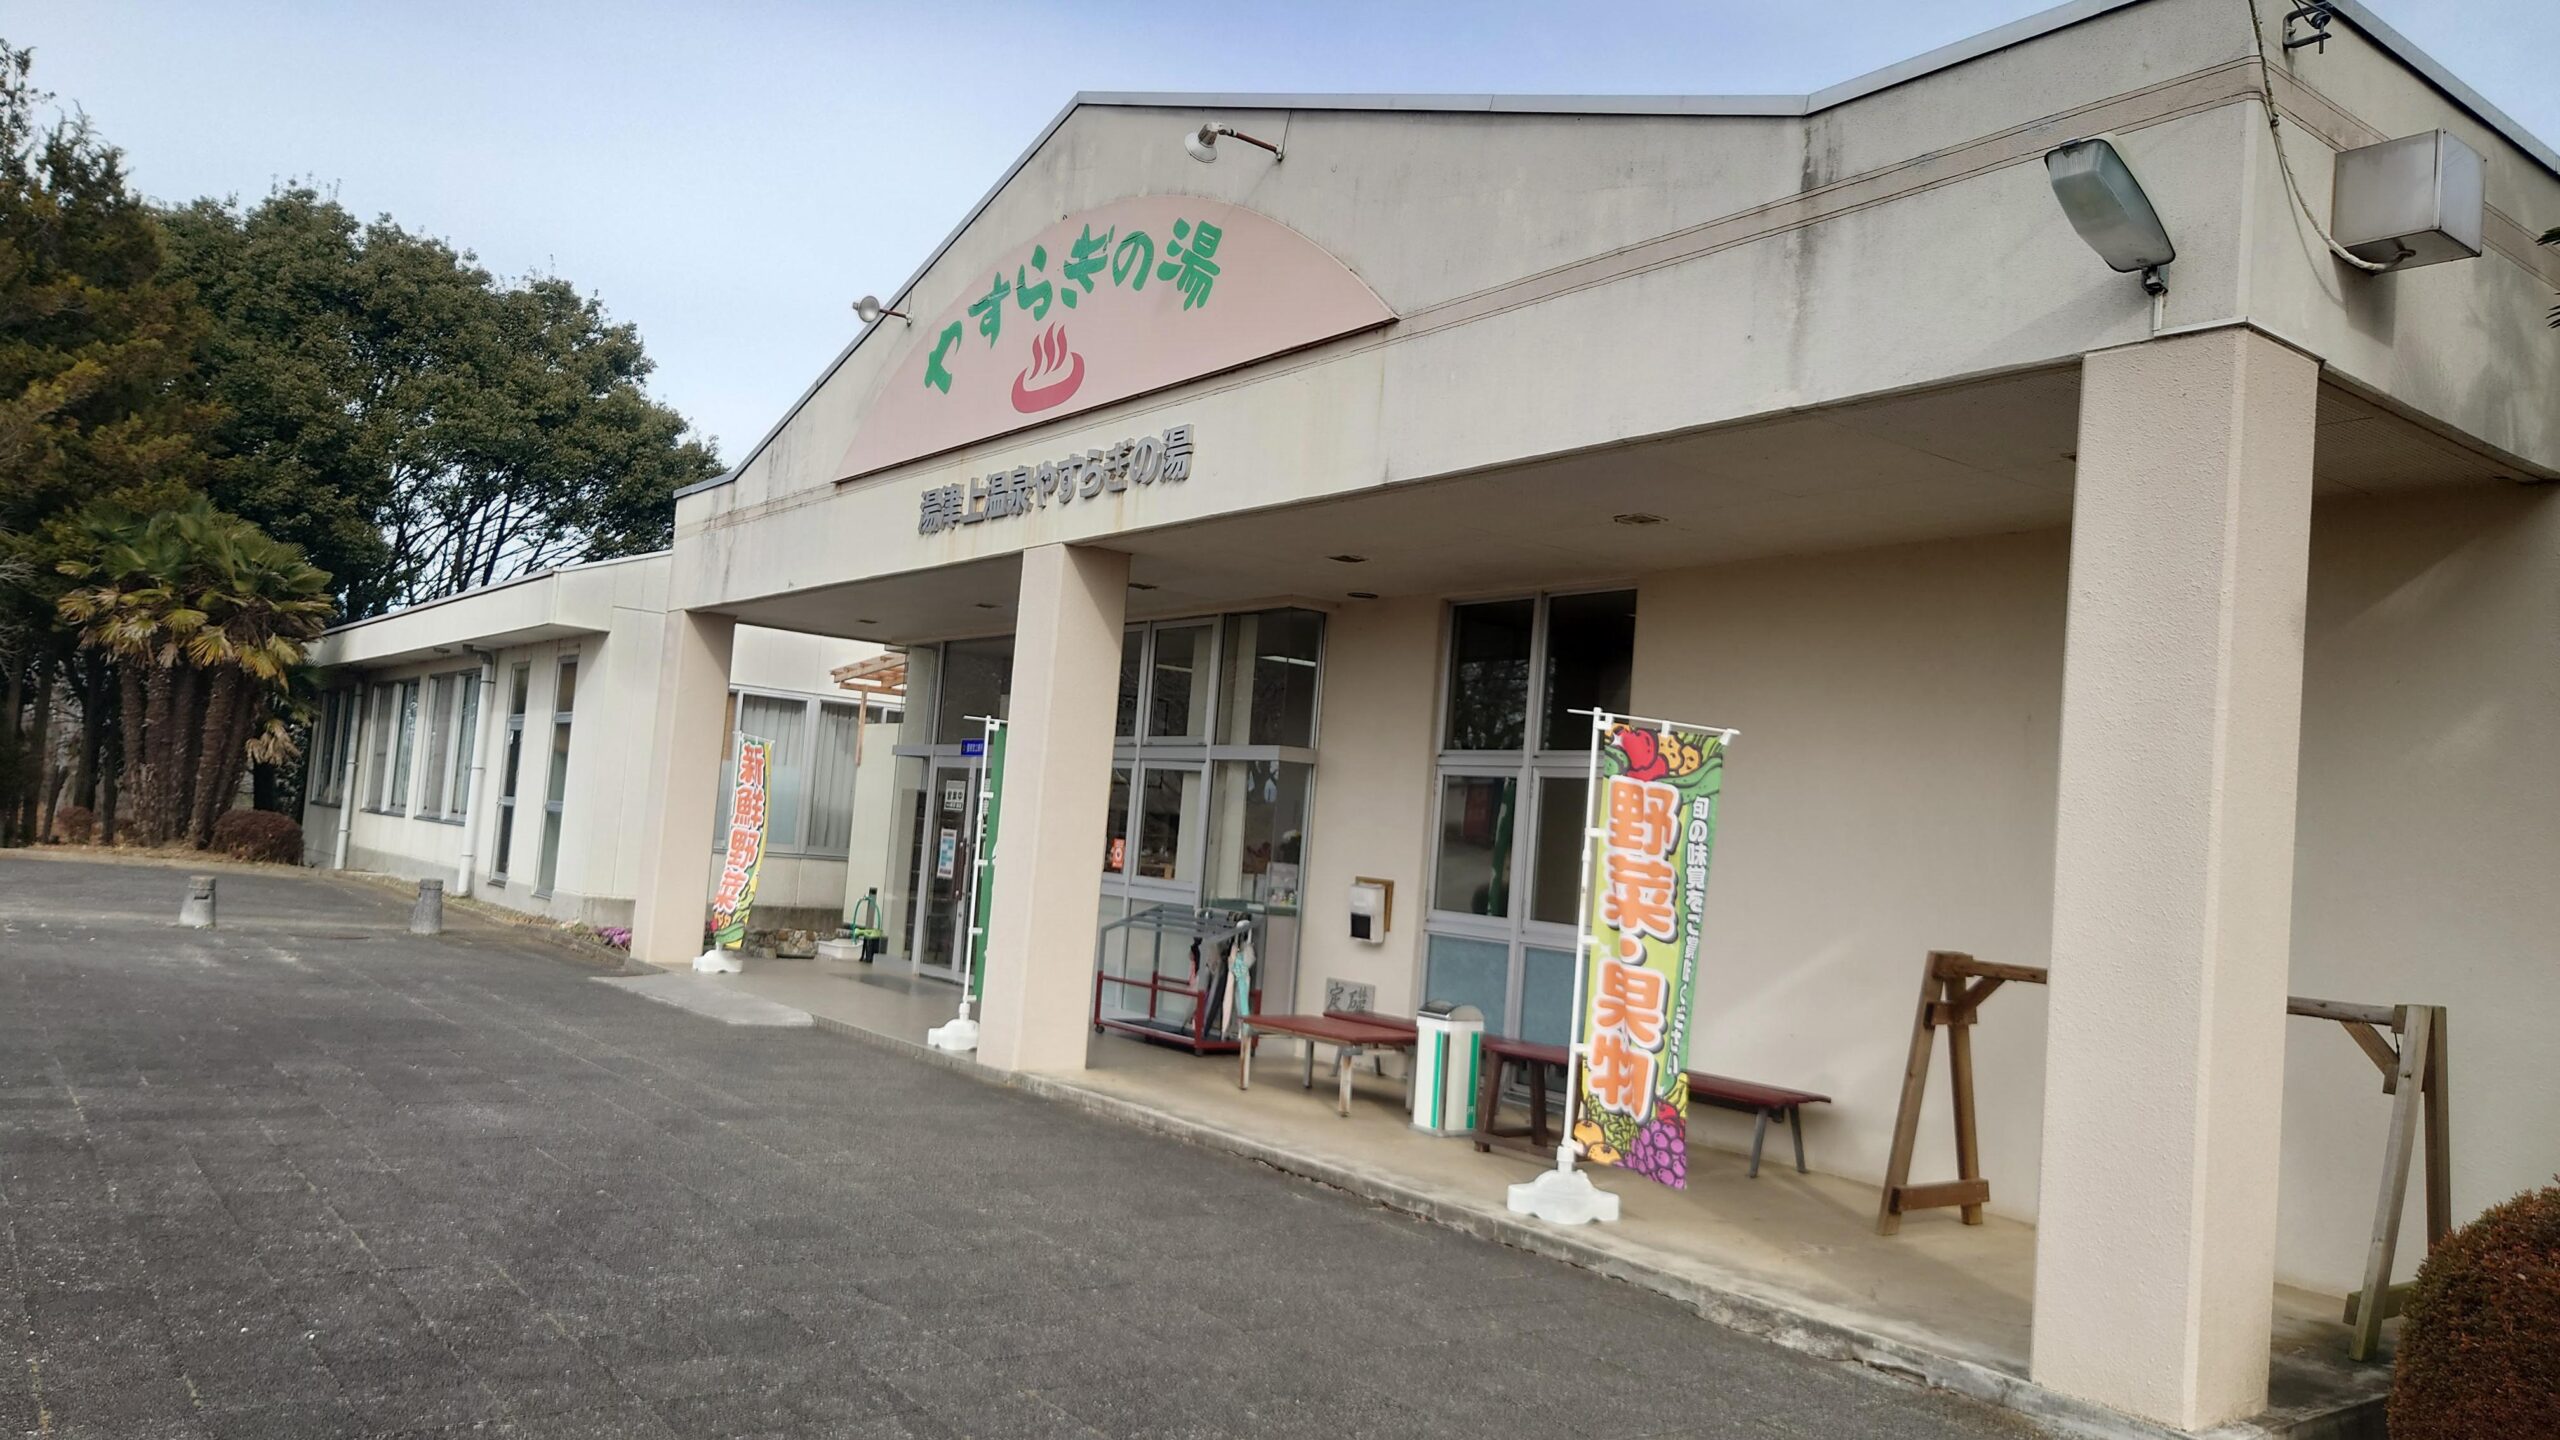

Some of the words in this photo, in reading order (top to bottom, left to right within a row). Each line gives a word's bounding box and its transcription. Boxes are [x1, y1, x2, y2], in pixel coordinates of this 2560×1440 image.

[925, 218, 1223, 394] やすらぎの湯
[918, 424, 1195, 534] 湯津上温泉やすらぎの湯
[714, 744, 764, 912] 新鮮野菜
[1590, 776, 1679, 1120] 野菜・果物
